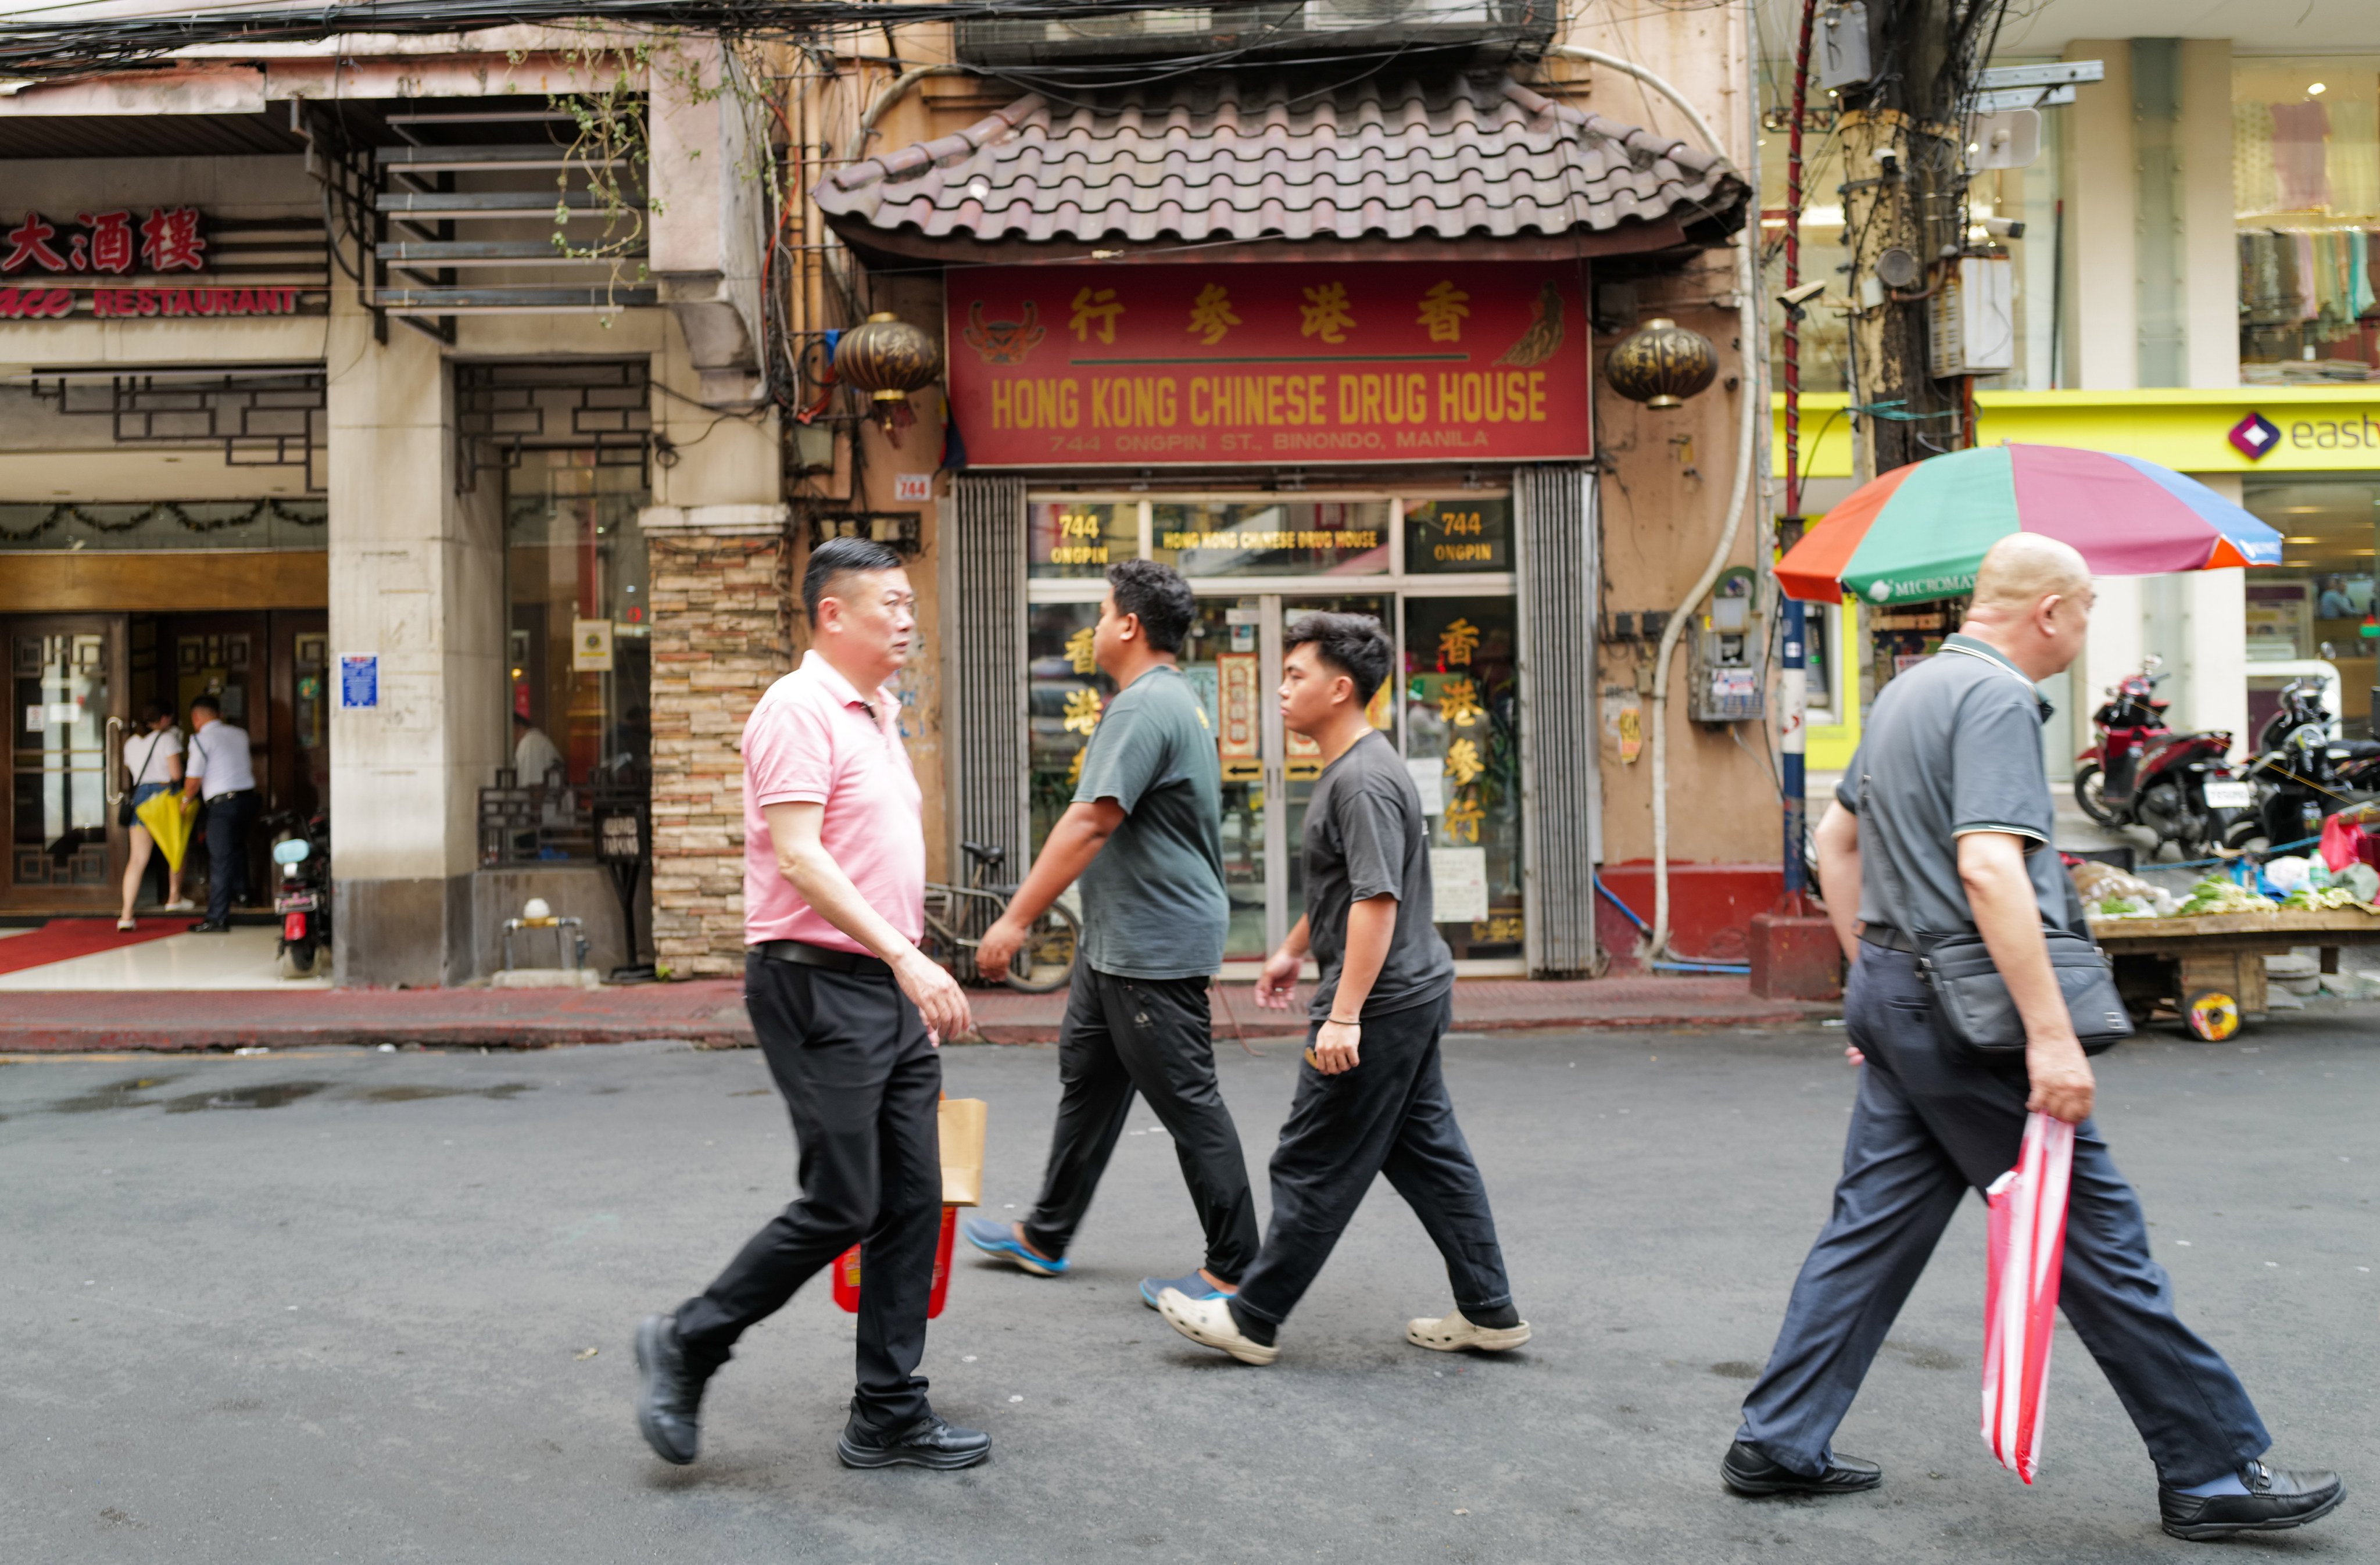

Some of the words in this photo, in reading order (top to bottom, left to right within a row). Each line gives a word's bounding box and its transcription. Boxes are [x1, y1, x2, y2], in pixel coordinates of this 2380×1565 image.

[1, 206, 206, 273] 大酒樓
[93, 287, 298, 316] RESTAURANT
[992, 378, 1079, 429] HONG
[1091, 377, 1177, 428] KONG
[1190, 375, 1327, 427] CHINESE
[1339, 373, 1427, 425] DRUG
[1438, 371, 1547, 423] HOUSE
[1050, 436, 1101, 452] 744
[1115, 434, 1207, 452] ONGPIN
[1272, 432, 1387, 450] BINONDO,
[1395, 430, 1489, 448] MANILA
[2292, 412, 2380, 448] east
[1058, 514, 1100, 539] 744
[1441, 511, 1482, 536] 744
[1163, 531, 1200, 549] HONG
[1201, 531, 1239, 549] KONG
[1240, 531, 1295, 549] CHINESE
[1297, 531, 1333, 549] DRUG
[1334, 530, 1378, 548] HOUSE
[1434, 543, 1492, 561] ONGPIN
[1050, 546, 1108, 564] ONGPIN
